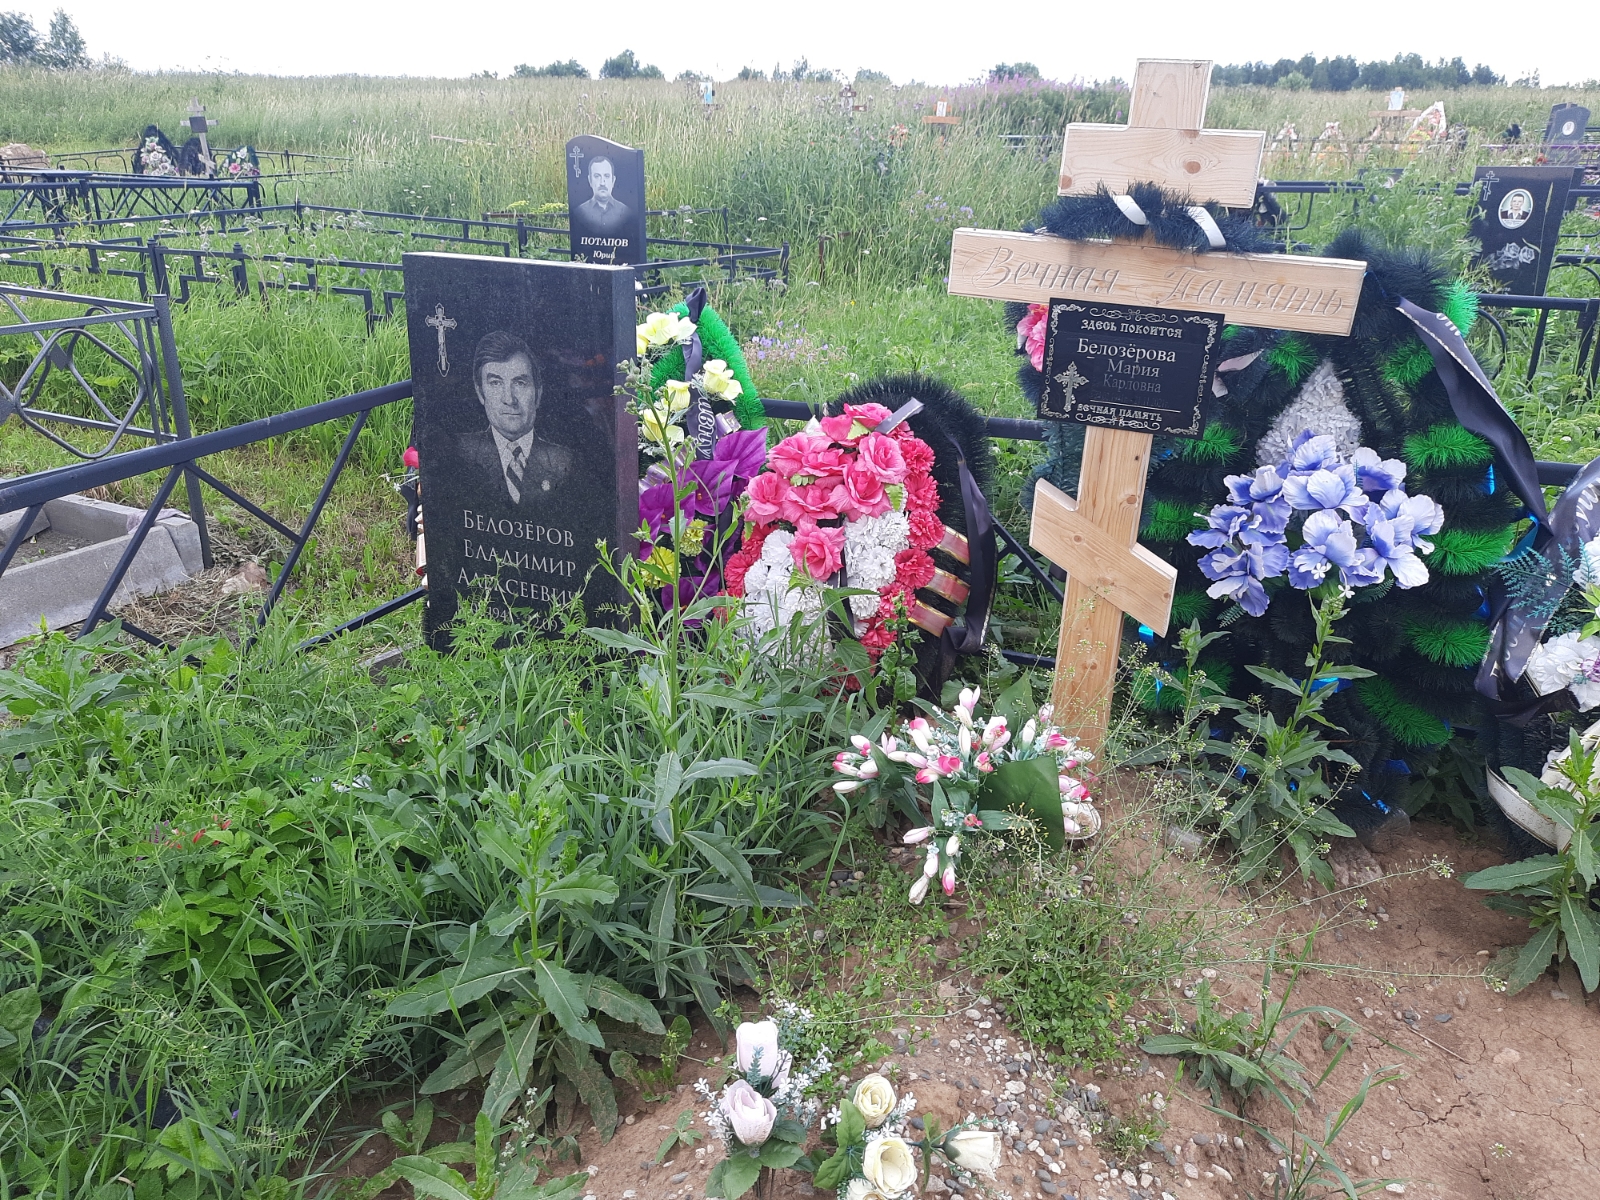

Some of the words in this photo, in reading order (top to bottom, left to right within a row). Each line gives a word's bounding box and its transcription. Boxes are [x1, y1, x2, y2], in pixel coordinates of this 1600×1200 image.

[580, 236, 629, 247] ПОТАПОВ
[962, 246, 1120, 295] Вечная
[1136, 264, 1343, 316] Память
[1076, 338, 1177, 363] Белозёрова
[1107, 358, 1161, 378] Мария
[1103, 373, 1162, 393] Карловна
[463, 509, 575, 548] БЕЛОЗЁРОВ
[463, 538, 576, 578] ВЛАДИМИР
